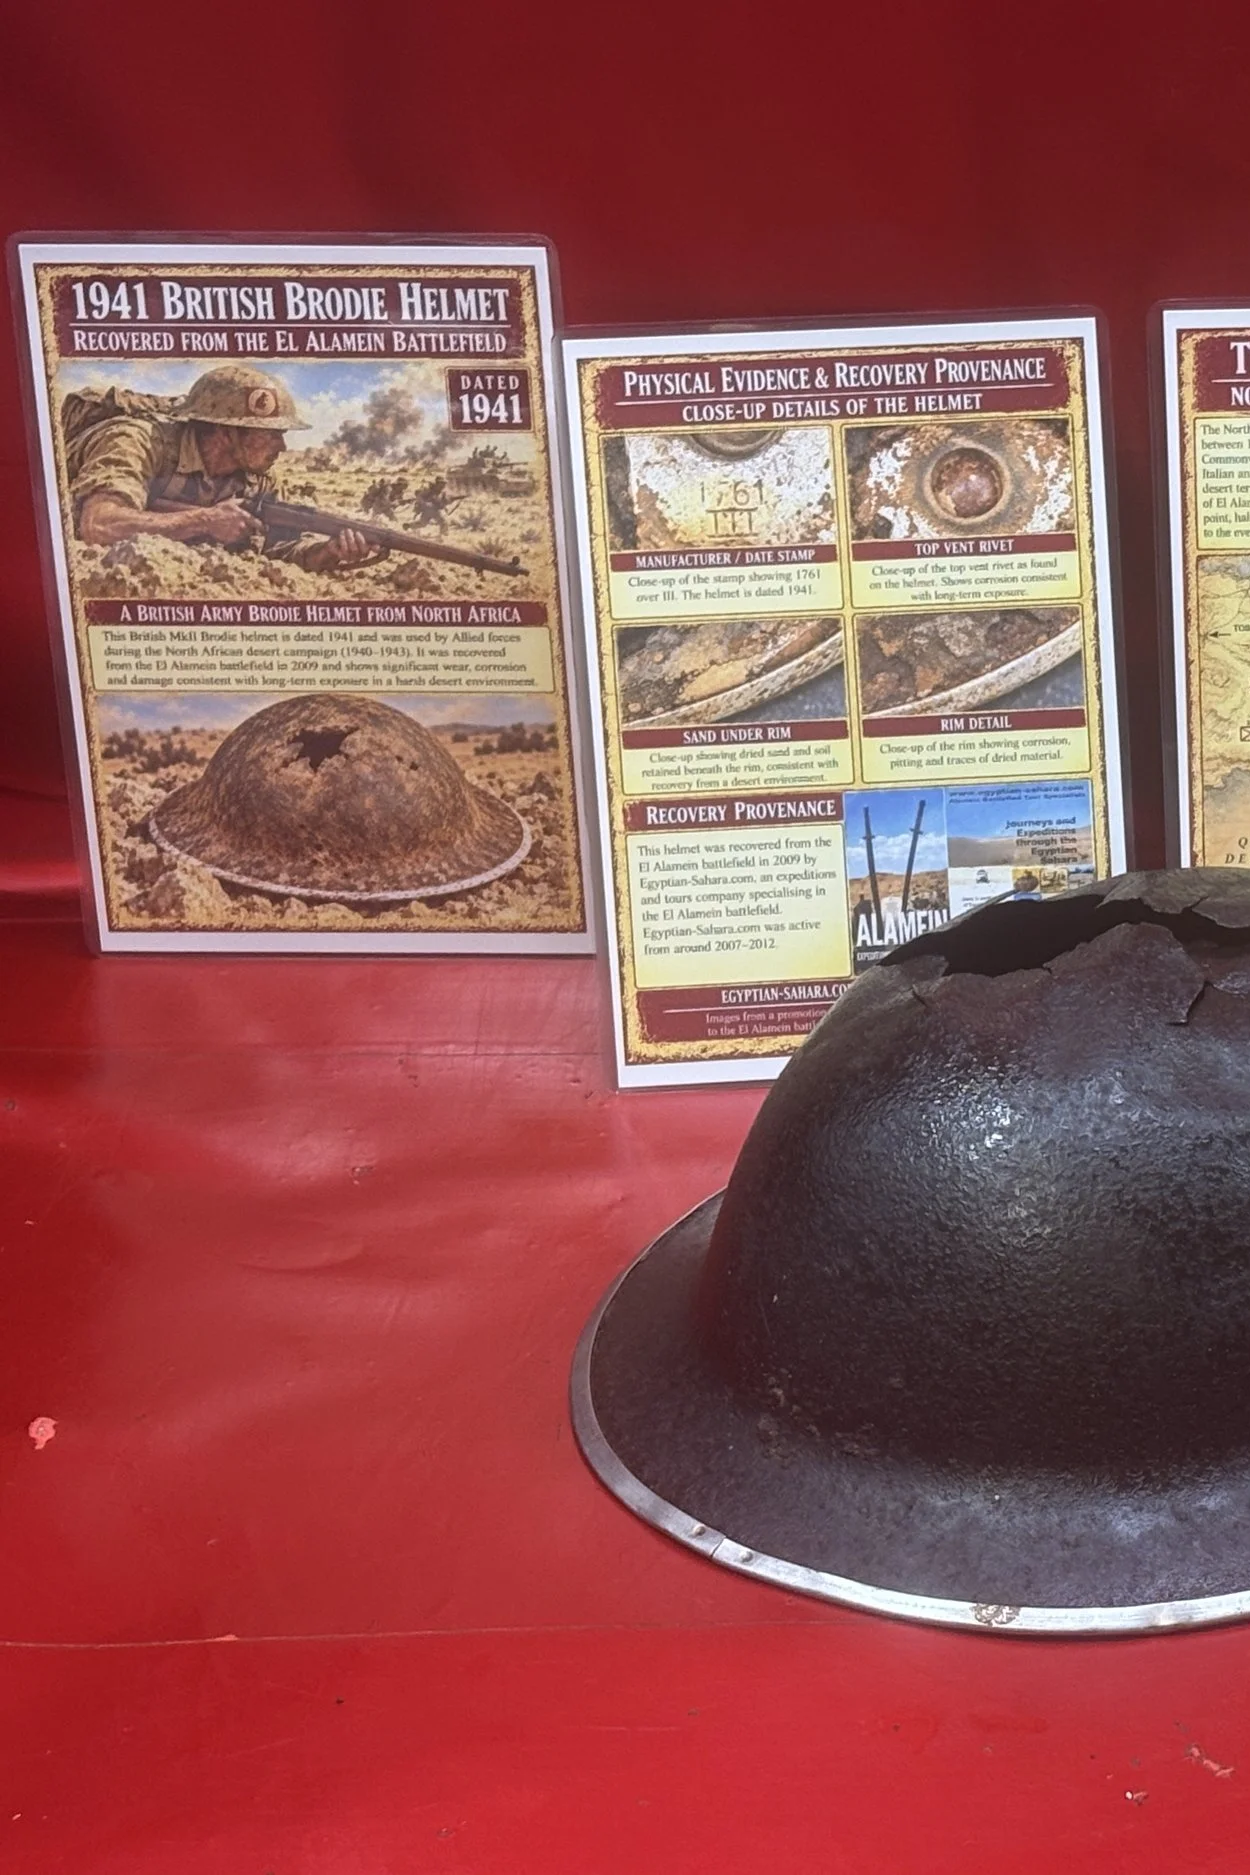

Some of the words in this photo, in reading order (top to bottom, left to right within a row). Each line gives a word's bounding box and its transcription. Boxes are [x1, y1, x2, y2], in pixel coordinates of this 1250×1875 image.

[74, 281, 146, 319] 1941
[162, 281, 274, 320] BRITISH
[285, 281, 388, 320] BRODIE
[400, 282, 509, 321] HELMET
[74, 330, 174, 351] RECOVERED
[180, 332, 228, 351] FROM
[234, 332, 268, 351] THE
[276, 330, 298, 351] EL
[306, 330, 384, 352] ALAMEIN
[392, 330, 506, 352] BATTLEFIELD
[460, 375, 519, 390] DATED
[624, 371, 715, 396] PHYSICAL
[721, 367, 810, 392] EVIDENCE
[814, 366, 829, 388] &
[835, 362, 927, 387] RECOVERY
[935, 357, 1046, 383] PROVENANCE
[462, 394, 520, 423] 1941
[682, 402, 766, 422] CLOSE-UP
[772, 399, 840, 418] DETAILS
[845, 398, 868, 415] OF
[873, 396, 908, 414] THE
[914, 393, 982, 412] HELMET
[1200, 423, 1220, 435] The
[1200, 438, 1243, 450] between
[914, 542, 940, 555] TOP
[943, 540, 974, 554] VENT
[979, 538, 1014, 552] RIVET
[635, 552, 731, 568] MANUFACTURER
[734, 551, 740, 563] /
[744, 550, 774, 563] DATE
[777, 549, 815, 561] STAMP
[628, 576, 676, 588] Close-up
[678, 573, 690, 585] of
[692, 573, 710, 584] the
[712, 574, 745, 585] stamp
[748, 570, 792, 583] showing
[796, 568, 820, 580] 1761
[120, 604, 131, 621] A
[137, 604, 194, 621] BRITISH
[200, 604, 242, 621] ARMY
[248, 604, 301, 622] BRODIE
[306, 605, 361, 622] HELMET
[367, 606, 406, 622] FROM
[412, 605, 461, 622] NORTH
[468, 605, 521, 622] AFRICA
[104, 645, 142, 659] during
[144, 645, 162, 656] the
[164, 645, 198, 656] North
[200, 645, 243, 657] African
[245, 645, 280, 657] desert
[282, 648, 338, 659] campaign
[416, 646, 424, 657] It
[427, 649, 449, 657] was
[452, 646, 506, 657] recovered
[940, 717, 964, 731] RIM
[968, 715, 1012, 730] DETAIL
[682, 729, 716, 744] SAND
[720, 727, 763, 742] UNDER
[767, 726, 791, 740] RIM
[646, 805, 726, 824] RECOVERY
[734, 799, 836, 820] PROVENANCE
[1006, 819, 1053, 829] Journeys
[1056, 817, 1076, 825] and
[1017, 828, 1076, 837] Expeditions
[636, 844, 660, 856] This
[663, 843, 700, 855] helmet
[703, 844, 725, 853] was
[728, 838, 781, 852] recovered
[784, 837, 811, 849] from
[814, 836, 832, 847] the
[1016, 838, 1057, 846] through
[1031, 847, 1077, 856] Egyptian
[1041, 856, 1078, 864] Sahara
[638, 861, 650, 873] El
[653, 860, 698, 872] Alamein
[701, 855, 755, 869] battlefield
[758, 856, 769, 866] in
[772, 854, 800, 866] 2009
[803, 853, 816, 867] by
[639, 874, 756, 890] Egyptian-Sahara.com,
[760, 874, 773, 882] an
[775, 869, 836, 883] expeditions
